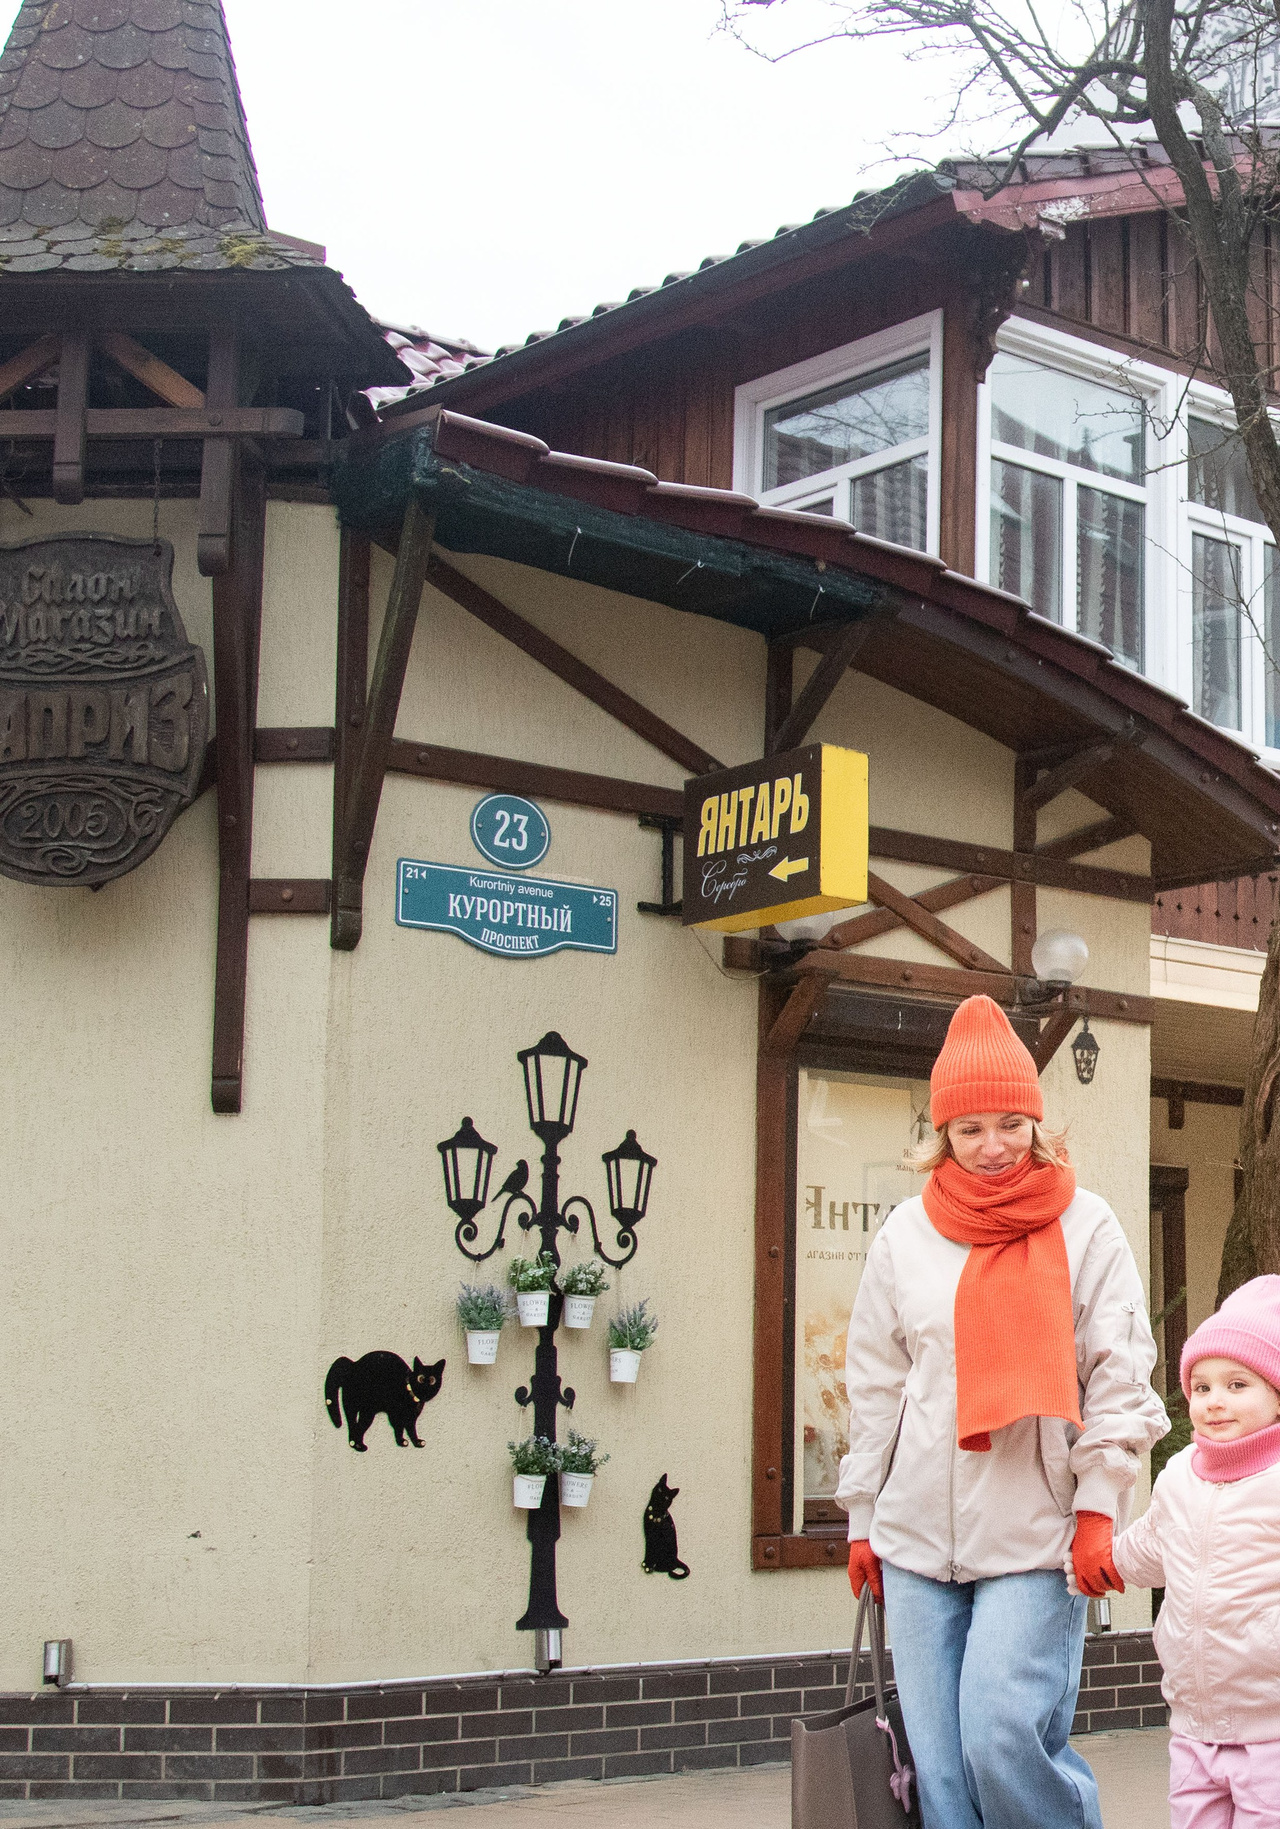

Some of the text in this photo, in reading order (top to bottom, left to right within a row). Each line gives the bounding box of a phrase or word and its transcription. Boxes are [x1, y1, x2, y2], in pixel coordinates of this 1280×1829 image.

[0, 599, 166, 649] Магазин
[21, 800, 109, 839] 2005
[494, 810, 529, 851] 23
[696, 772, 810, 857] ЯНТАРЬ
[405, 867, 419, 879] 21
[469, 876, 554, 899] Kurortniy avenue
[448, 893, 572, 933] КУРОРТНЫЙ
[599, 895, 612, 907] 25
[480, 927, 540, 950] ПРОСПЕКТ
